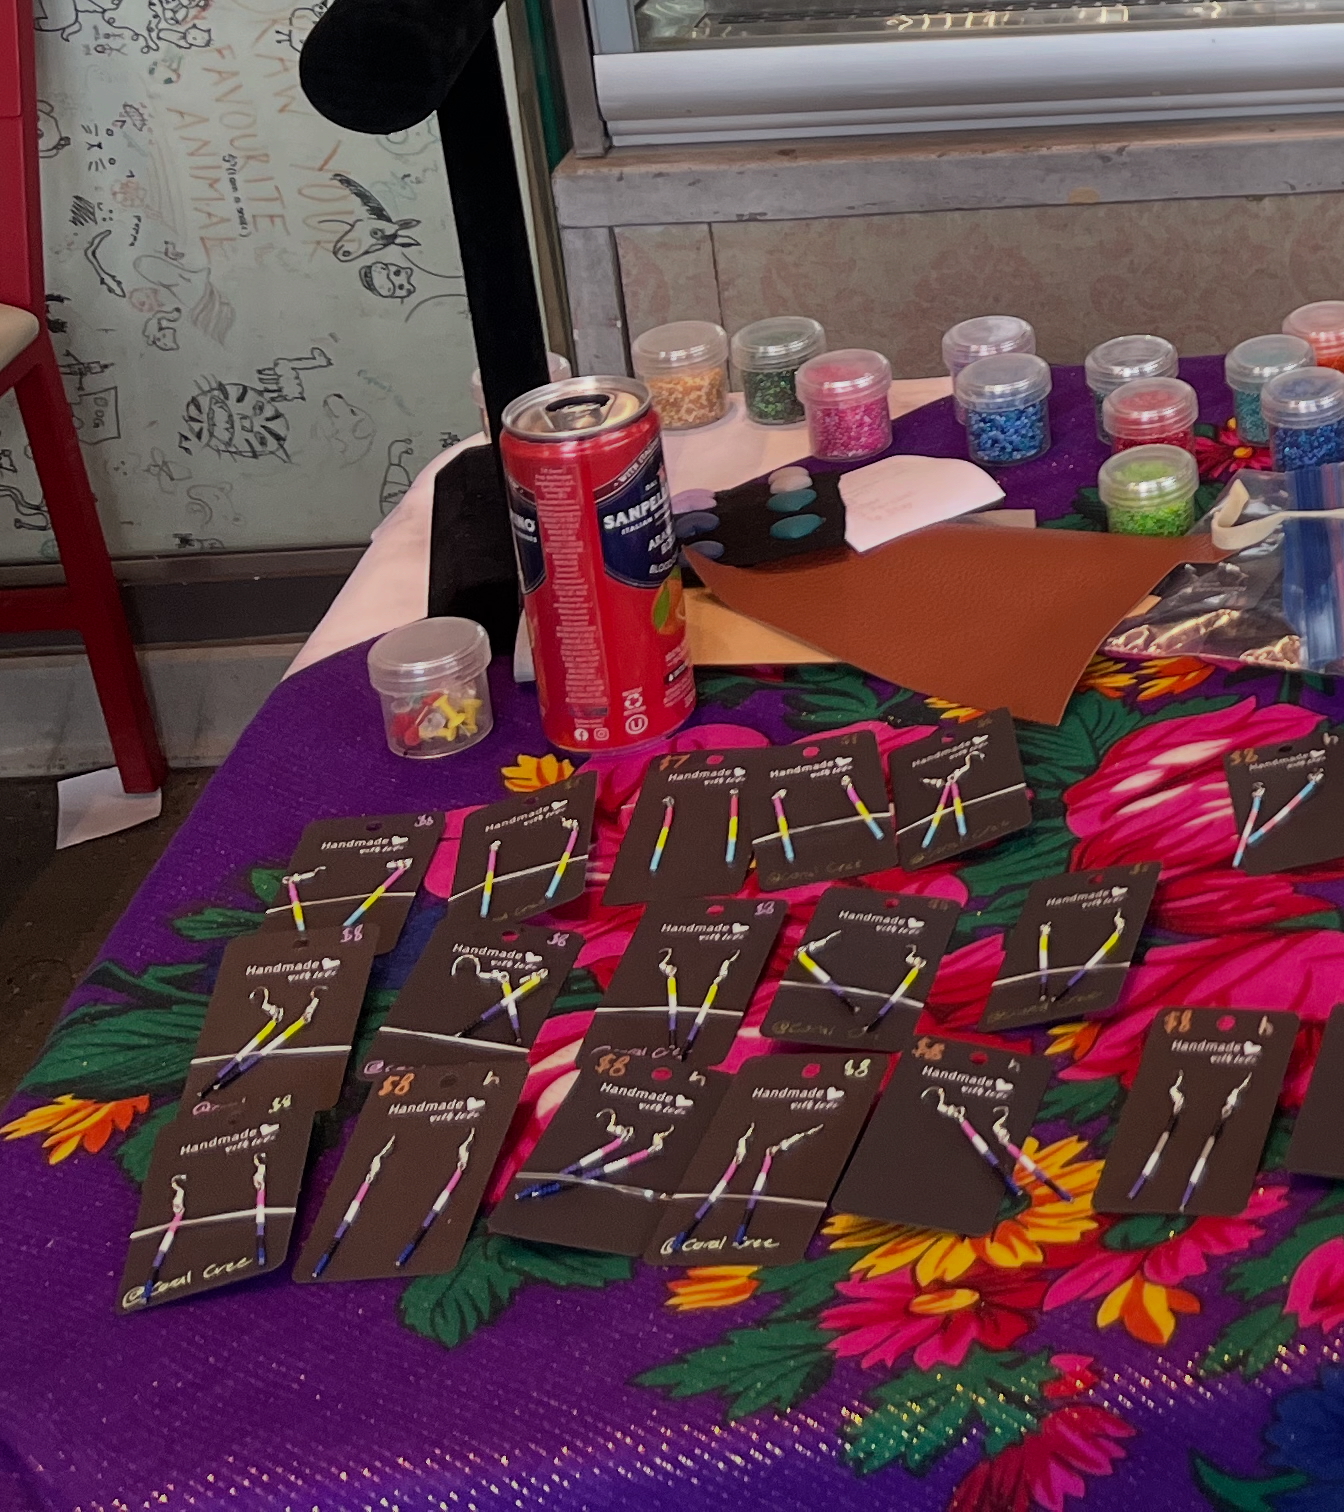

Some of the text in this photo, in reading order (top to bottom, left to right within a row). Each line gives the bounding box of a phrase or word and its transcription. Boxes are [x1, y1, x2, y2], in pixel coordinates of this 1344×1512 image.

[200, 44, 290, 236] FAVOURITE
[166, 108, 239, 263] ANIMAL
[618, 465, 639, 482] WITH
[911, 740, 974, 768] Handmade
[1249, 753, 1309, 772] Handmade
[668, 768, 732, 782] Handmade
[770, 759, 836, 778] Handmade
[485, 804, 549, 832] Handmade
[321, 836, 389, 850] Handmade
[1046, 889, 1110, 906] Handmade
[838, 910, 907, 928] Handmade
[340, 927, 364, 942] $8
[661, 923, 732, 934] Handmade
[452, 943, 523, 960] Handmade
[245, 958, 320, 976] Handmade
[1171, 1039, 1241, 1055] Handmade
[844, 1058, 870, 1078] $8
[921, 1066, 993, 1088] Handmade
[599, 1082, 674, 1105] Handmade
[751, 1086, 825, 1101] Handmade
[388, 1099, 464, 1116] Handmade
[180, 1127, 257, 1155] Handmade
